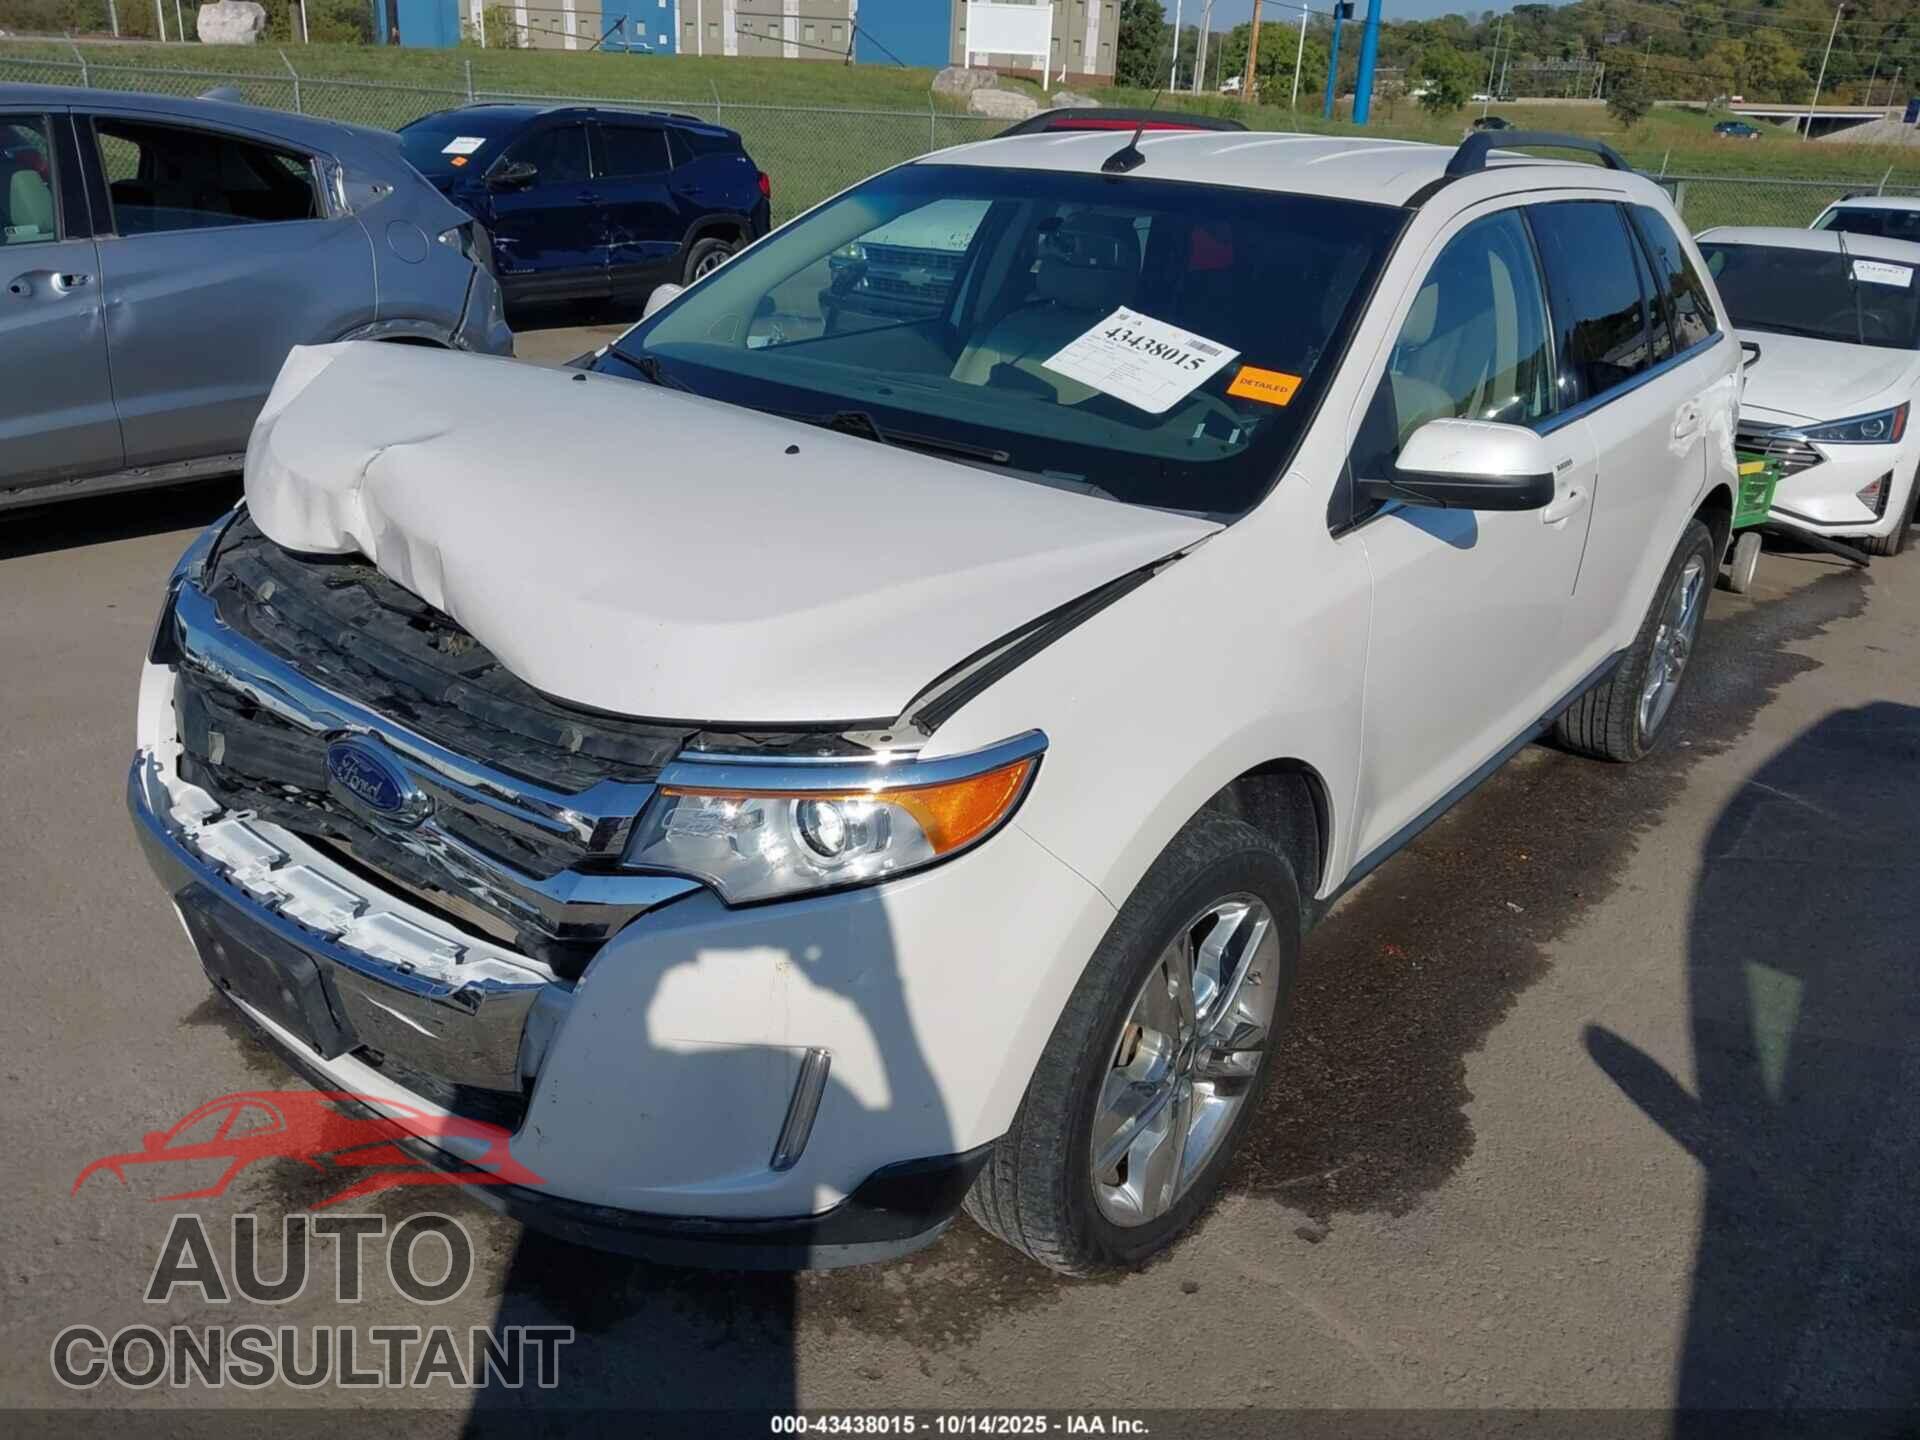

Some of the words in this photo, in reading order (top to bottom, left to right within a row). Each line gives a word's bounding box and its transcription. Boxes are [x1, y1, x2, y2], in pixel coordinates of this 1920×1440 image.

[1104, 327, 1206, 371] 43438015
[1240, 376, 1288, 393] DETAILED
[338, 752, 383, 799] Ford
